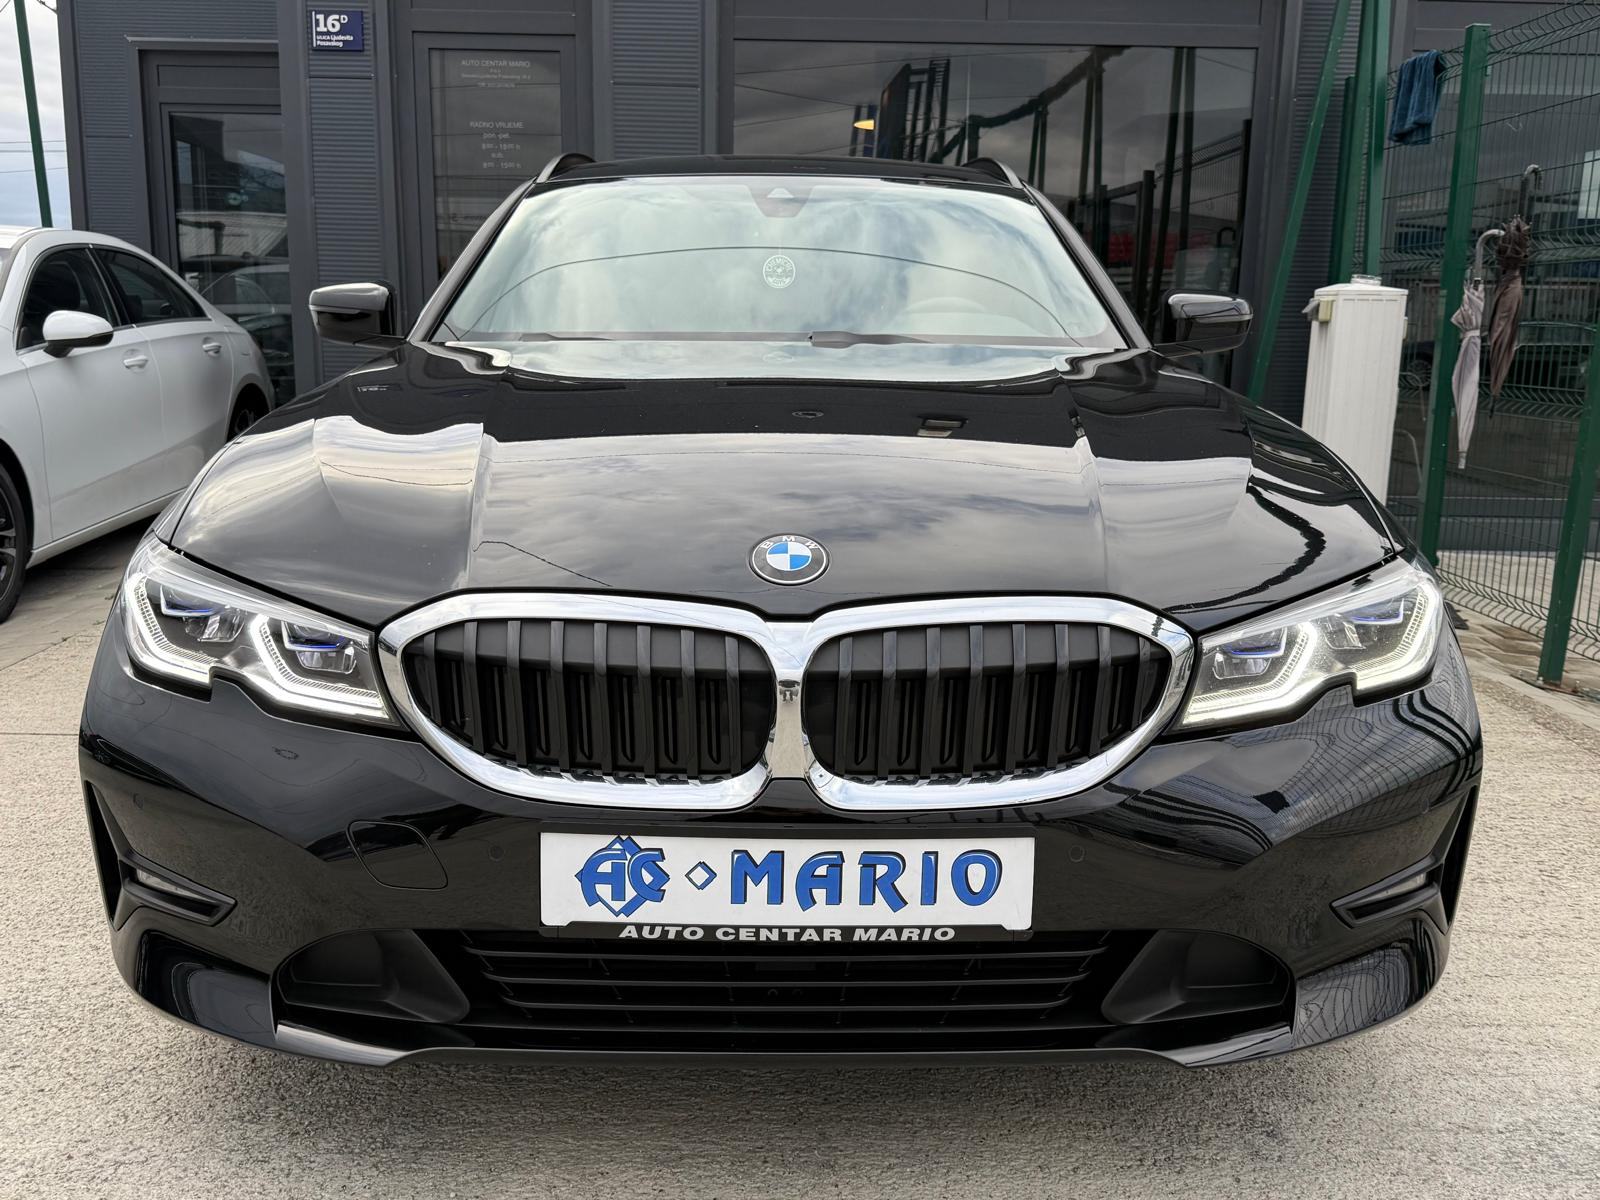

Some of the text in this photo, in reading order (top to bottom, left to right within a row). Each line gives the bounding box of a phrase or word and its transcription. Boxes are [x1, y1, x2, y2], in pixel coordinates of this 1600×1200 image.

[508, 60, 531, 68] MARIO
[469, 121, 525, 129] RADNO VRIJEME
[760, 535, 818, 549] BMW
[731, 849, 1004, 914] MARIO
[619, 925, 956, 942] AUTO CENTAR MARIO
